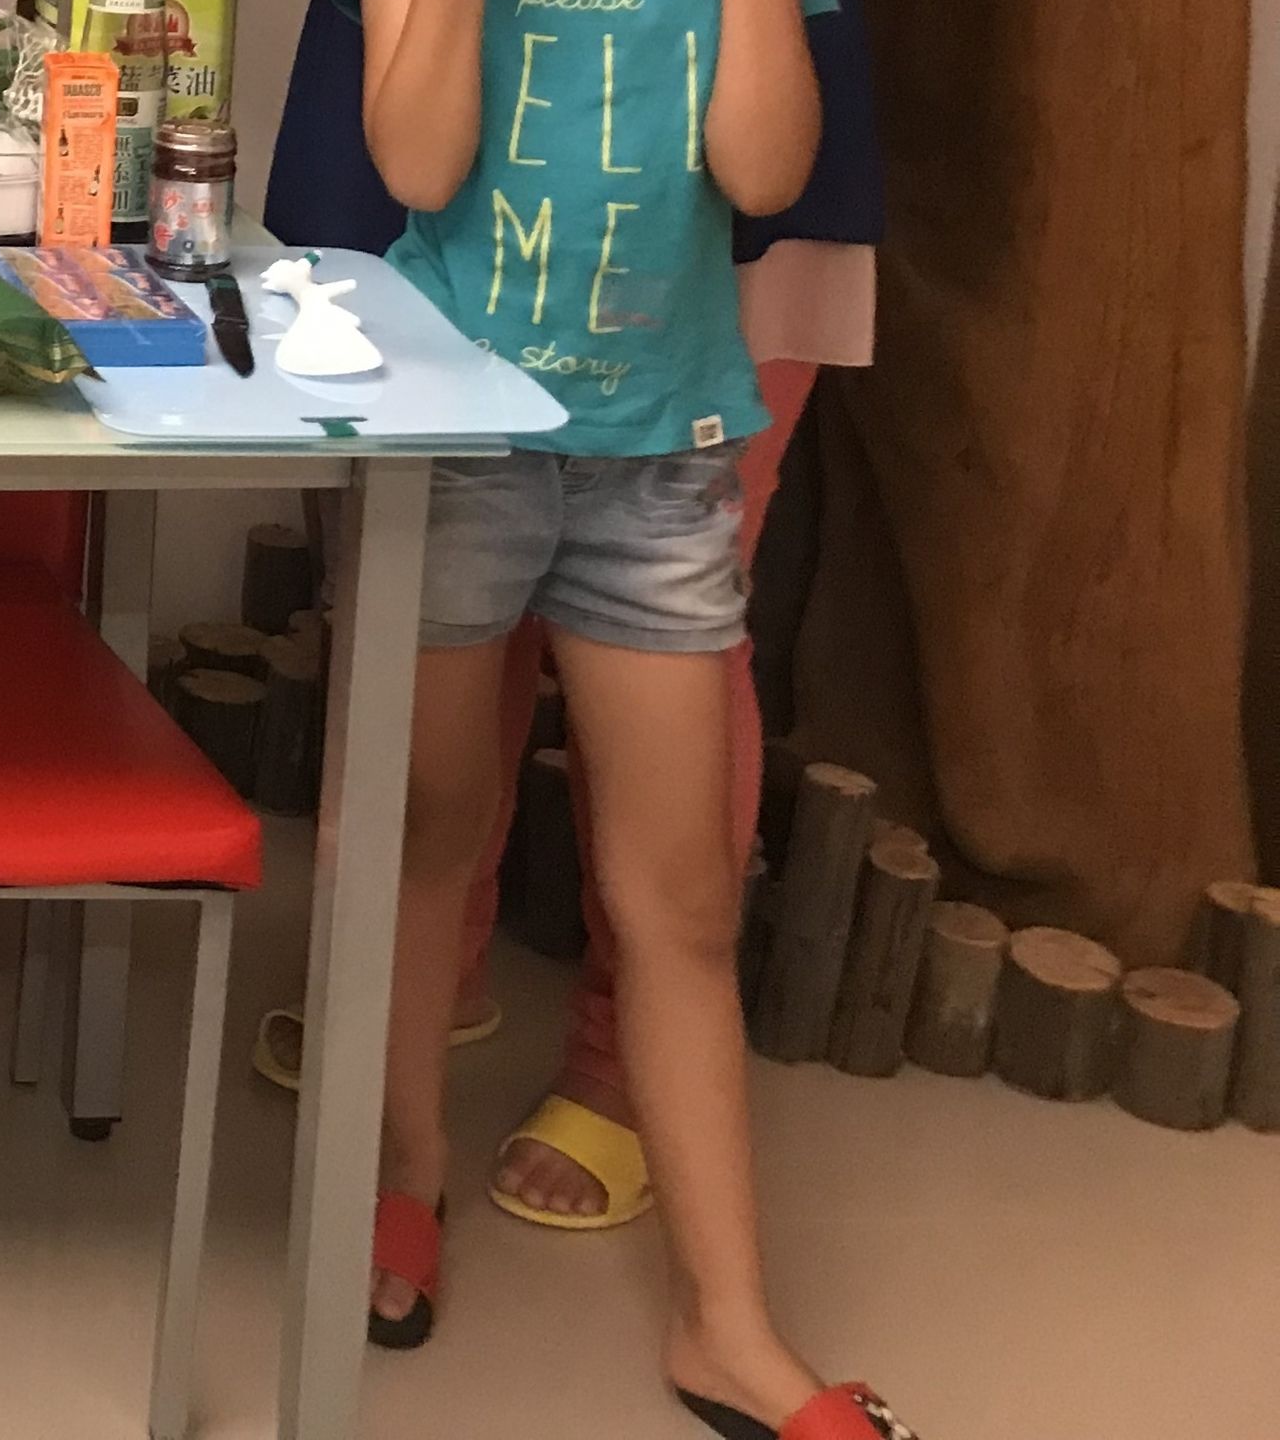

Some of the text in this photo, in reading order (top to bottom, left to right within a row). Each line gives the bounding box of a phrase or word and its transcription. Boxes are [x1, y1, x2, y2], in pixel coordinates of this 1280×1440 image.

[62, 84, 104, 97] TABASCO
[485, 188, 641, 334] ME
[519, 341, 631, 395] story
